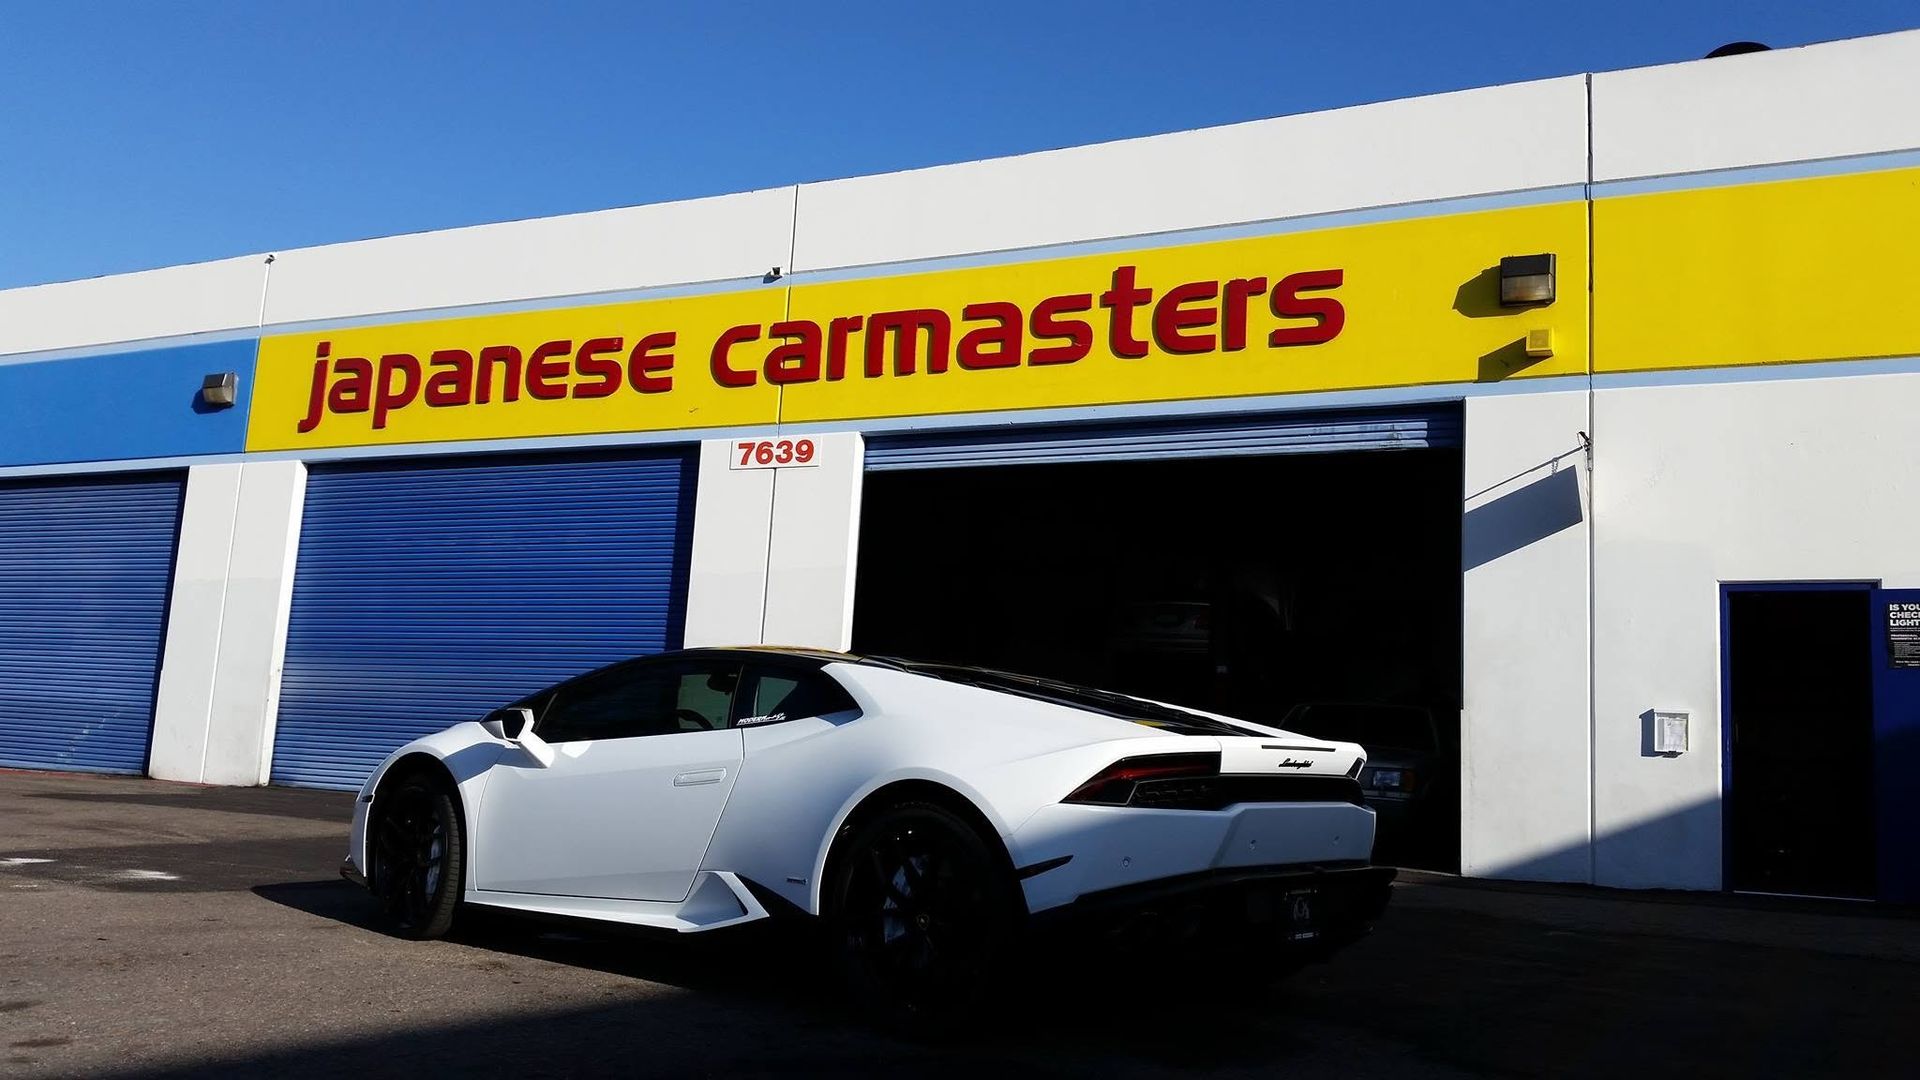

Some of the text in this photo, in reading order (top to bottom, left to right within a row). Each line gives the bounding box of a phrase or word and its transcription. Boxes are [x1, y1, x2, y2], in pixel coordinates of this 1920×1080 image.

[298, 266, 1345, 434] japanese carmasters
[738, 439, 815, 466] 7639
